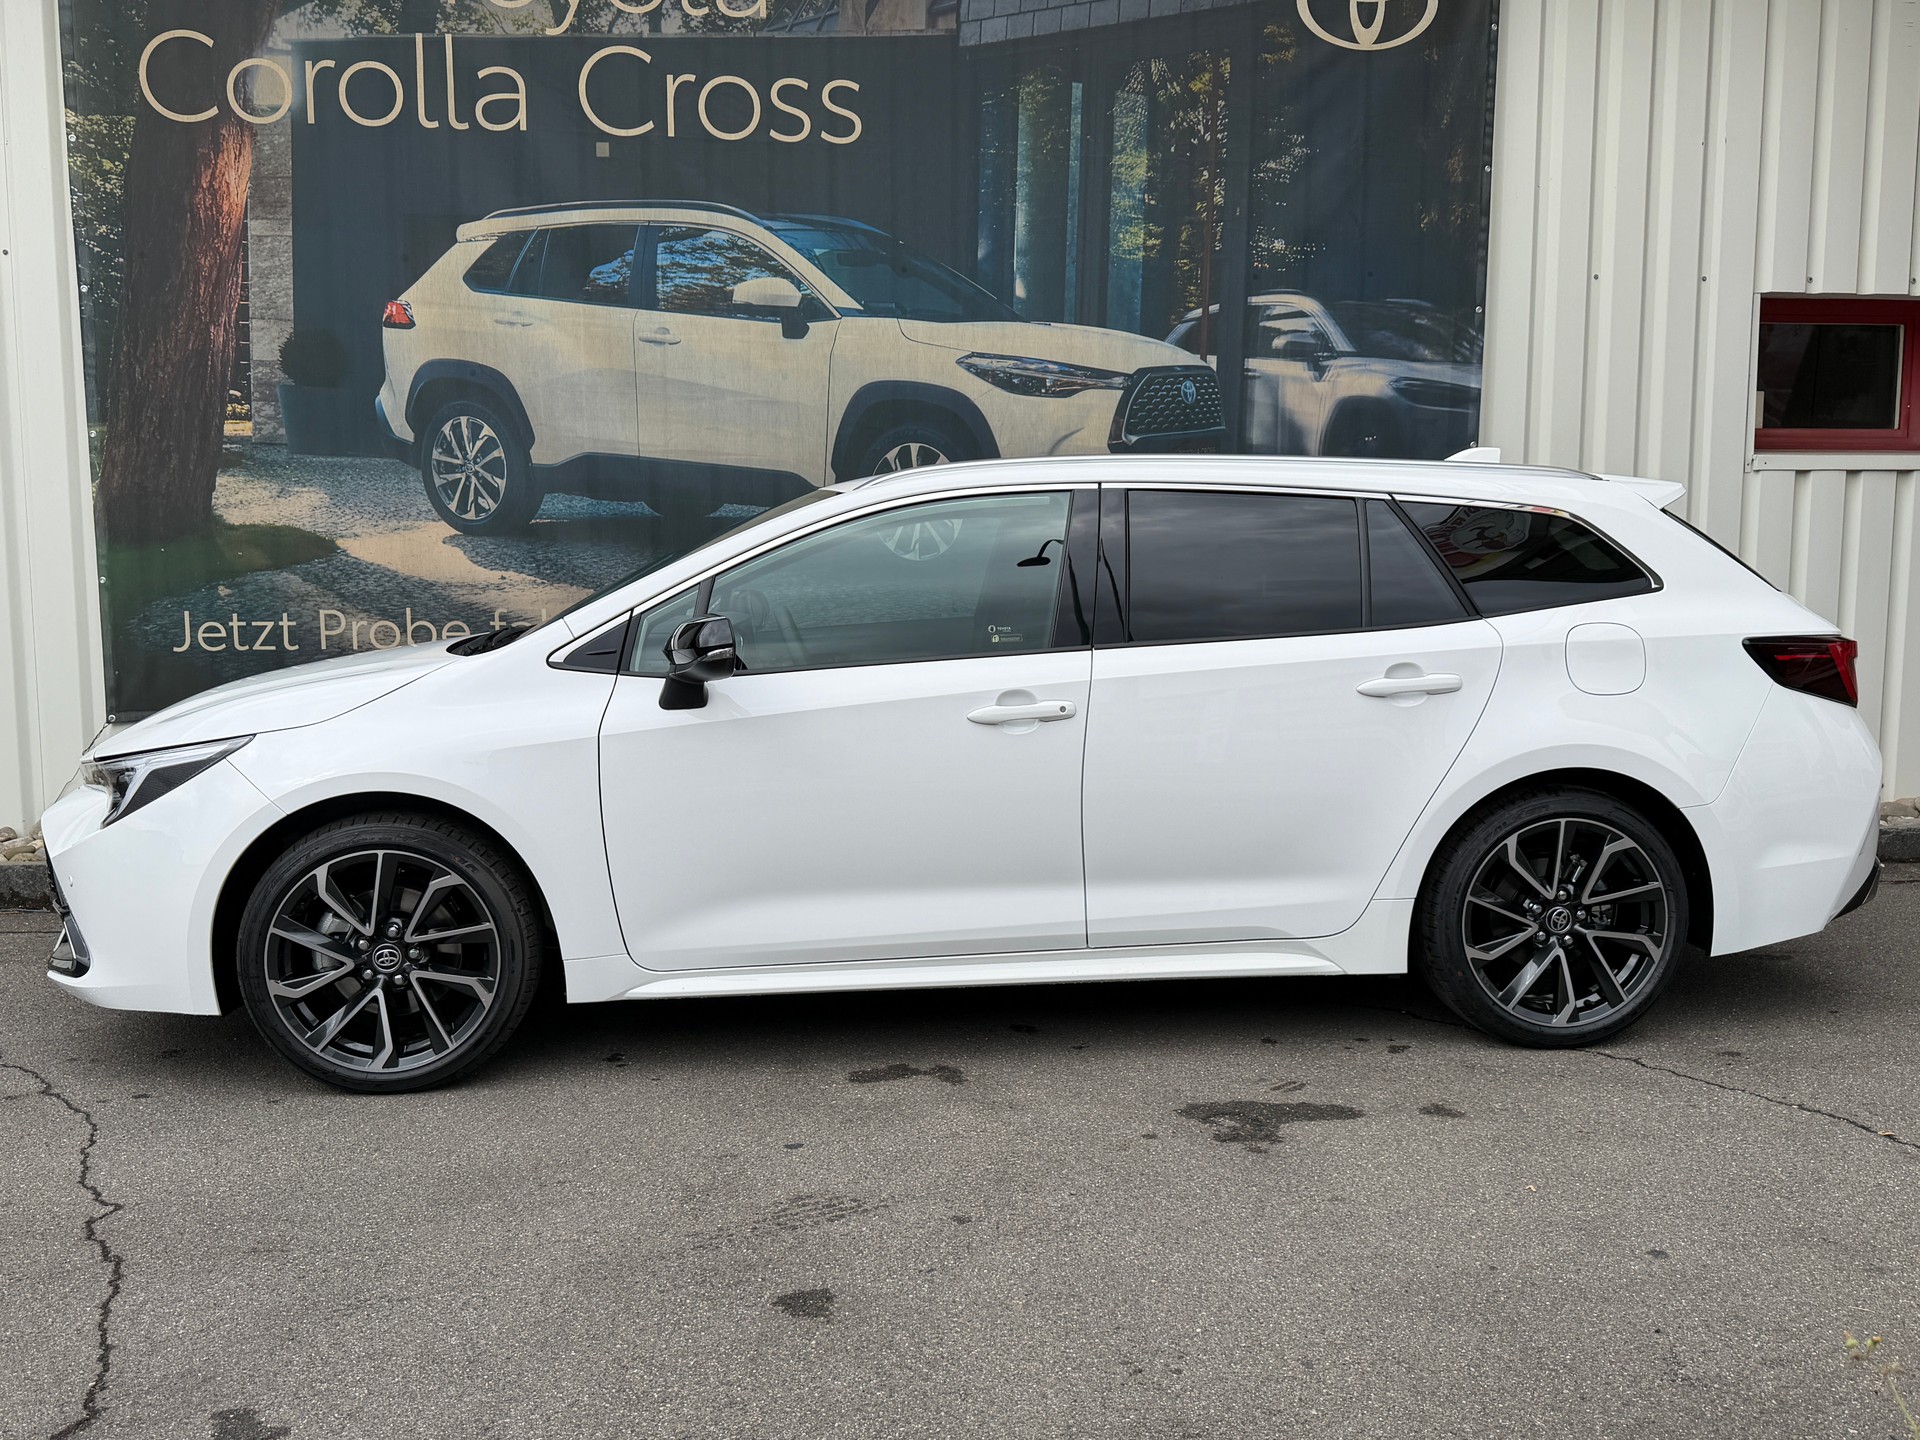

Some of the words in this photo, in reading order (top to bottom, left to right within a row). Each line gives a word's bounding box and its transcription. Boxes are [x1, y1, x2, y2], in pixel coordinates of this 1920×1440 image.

[139, 29, 527, 131] Corolla
[578, 45, 863, 145] Cross
[172, 610, 300, 653] Jetzt
[319, 607, 471, 650] Probe
